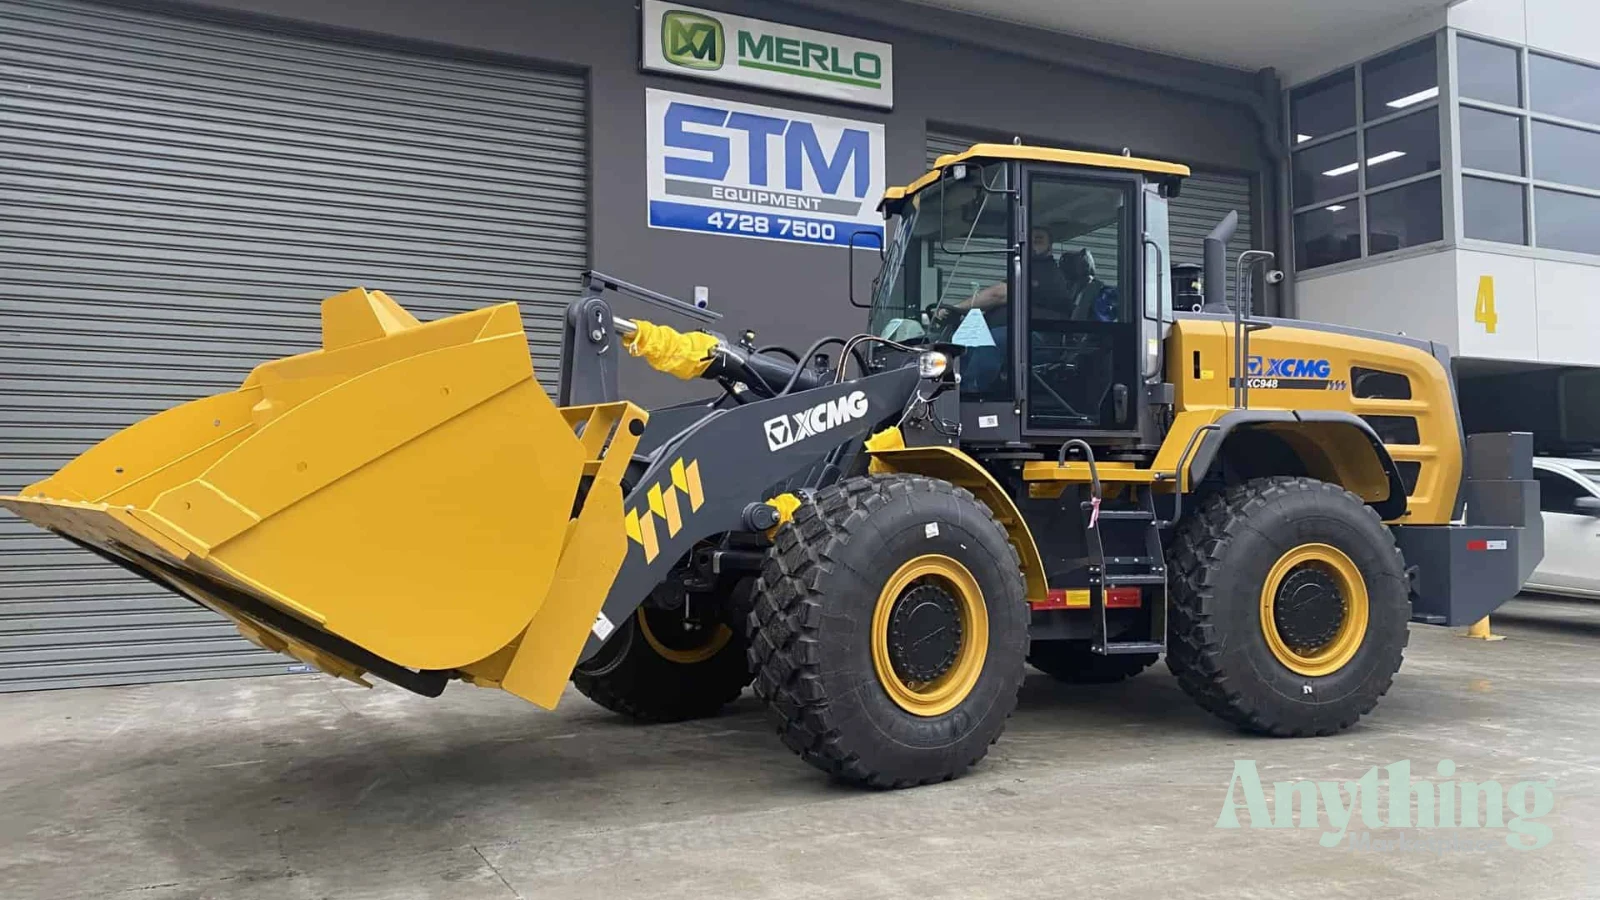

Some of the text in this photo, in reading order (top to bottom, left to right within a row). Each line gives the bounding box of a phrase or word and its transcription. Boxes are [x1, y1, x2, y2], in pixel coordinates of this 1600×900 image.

[738, 30, 881, 79] MERLO
[664, 102, 870, 199] STM
[712, 187, 821, 210] EQUIPMENT
[707, 211, 836, 241] 4728 7500
[1475, 275, 1498, 334] 4
[1266, 358, 1330, 378] XCMG
[792, 390, 869, 442] XCMG
